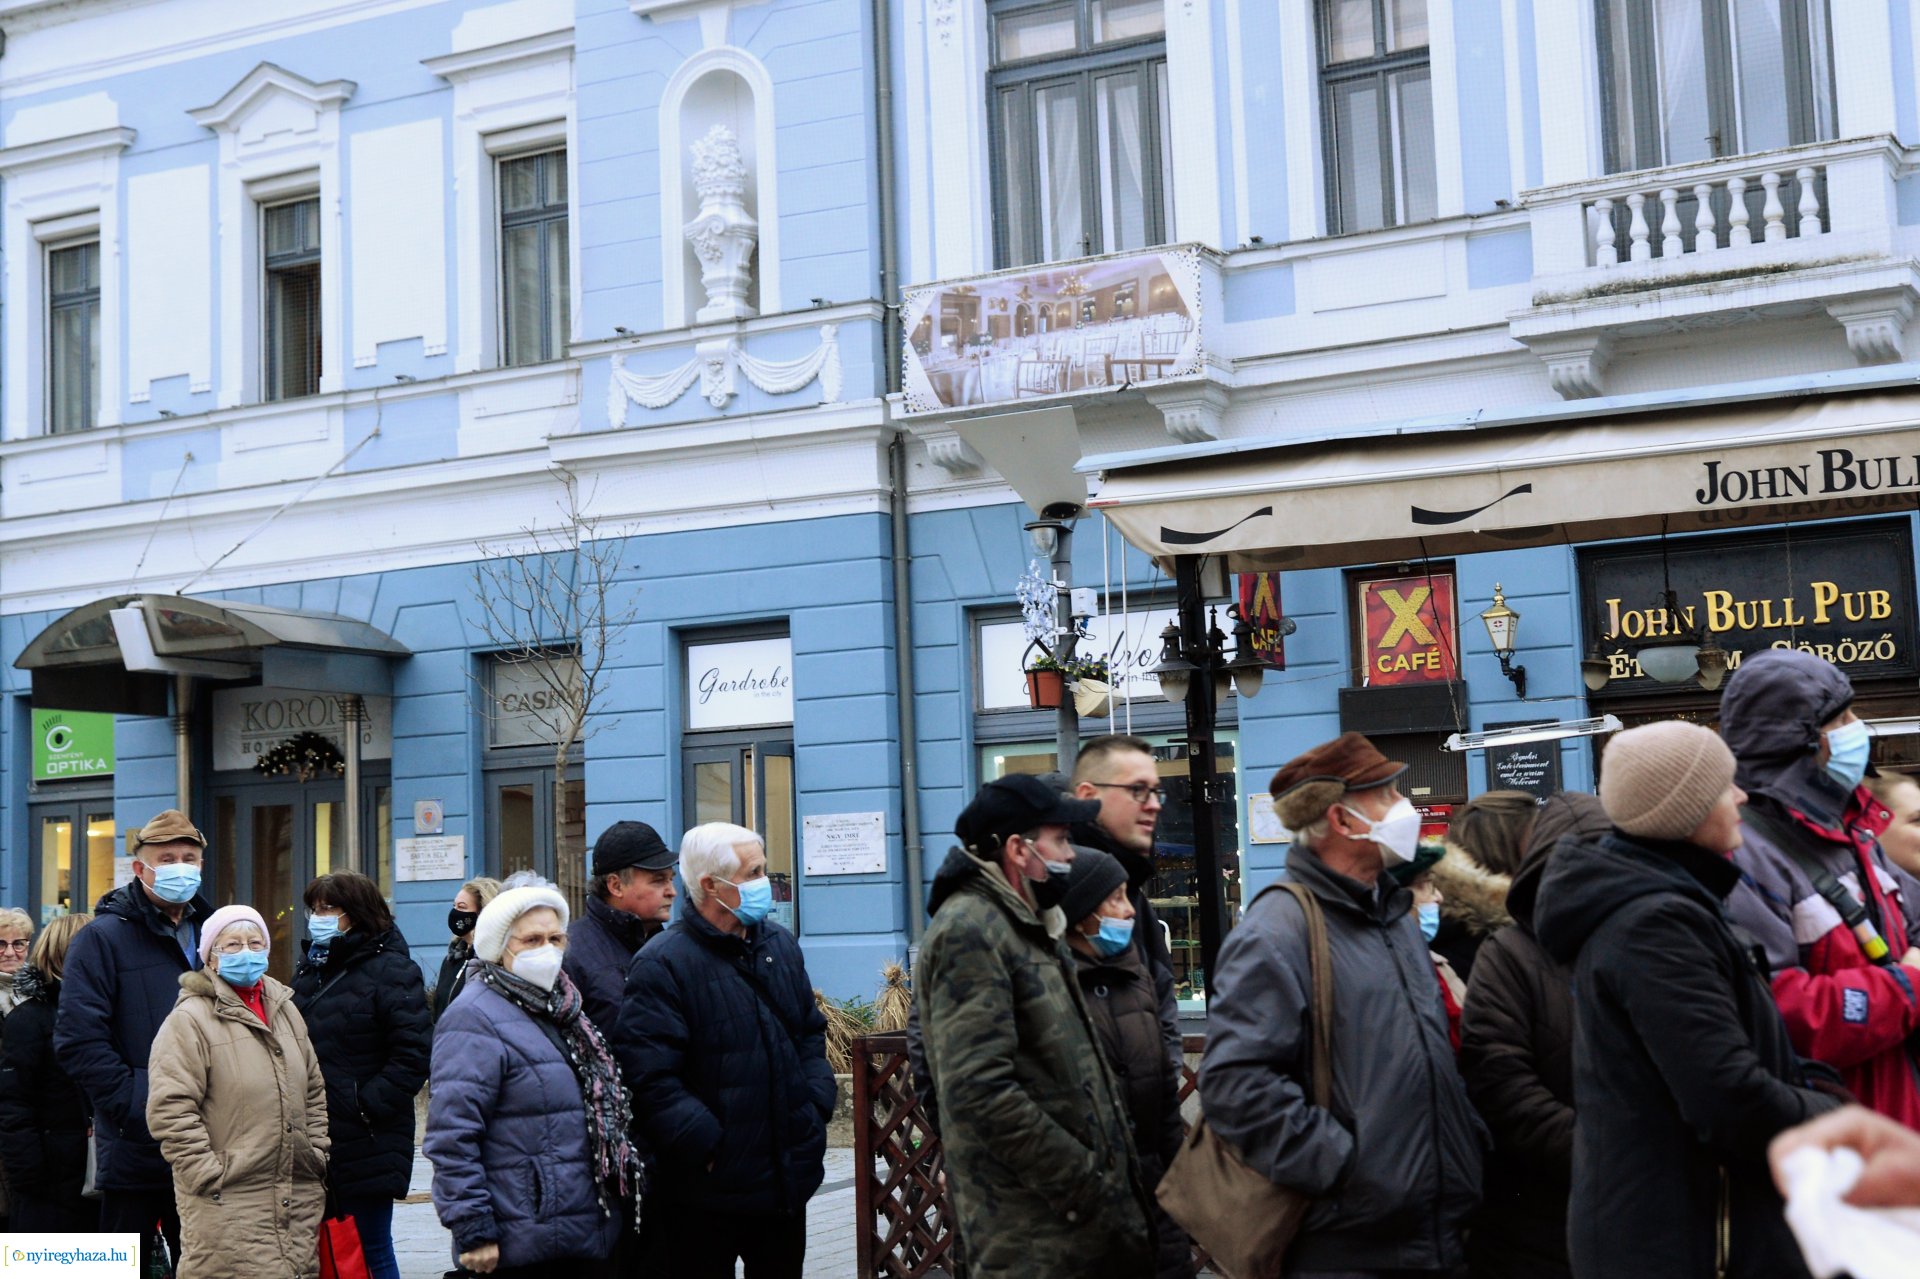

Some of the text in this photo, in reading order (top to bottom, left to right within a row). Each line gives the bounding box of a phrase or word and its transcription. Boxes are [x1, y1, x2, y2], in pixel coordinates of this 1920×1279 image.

[1696, 461, 1811, 505] JOHN
[1377, 587, 1439, 649] X
[1603, 581, 1892, 640] JOHN BULL PUB
[1377, 646, 1441, 673] CAFÉ
[698, 665, 789, 705] Gardrobe
[46, 758, 107, 774] OPTIKA
